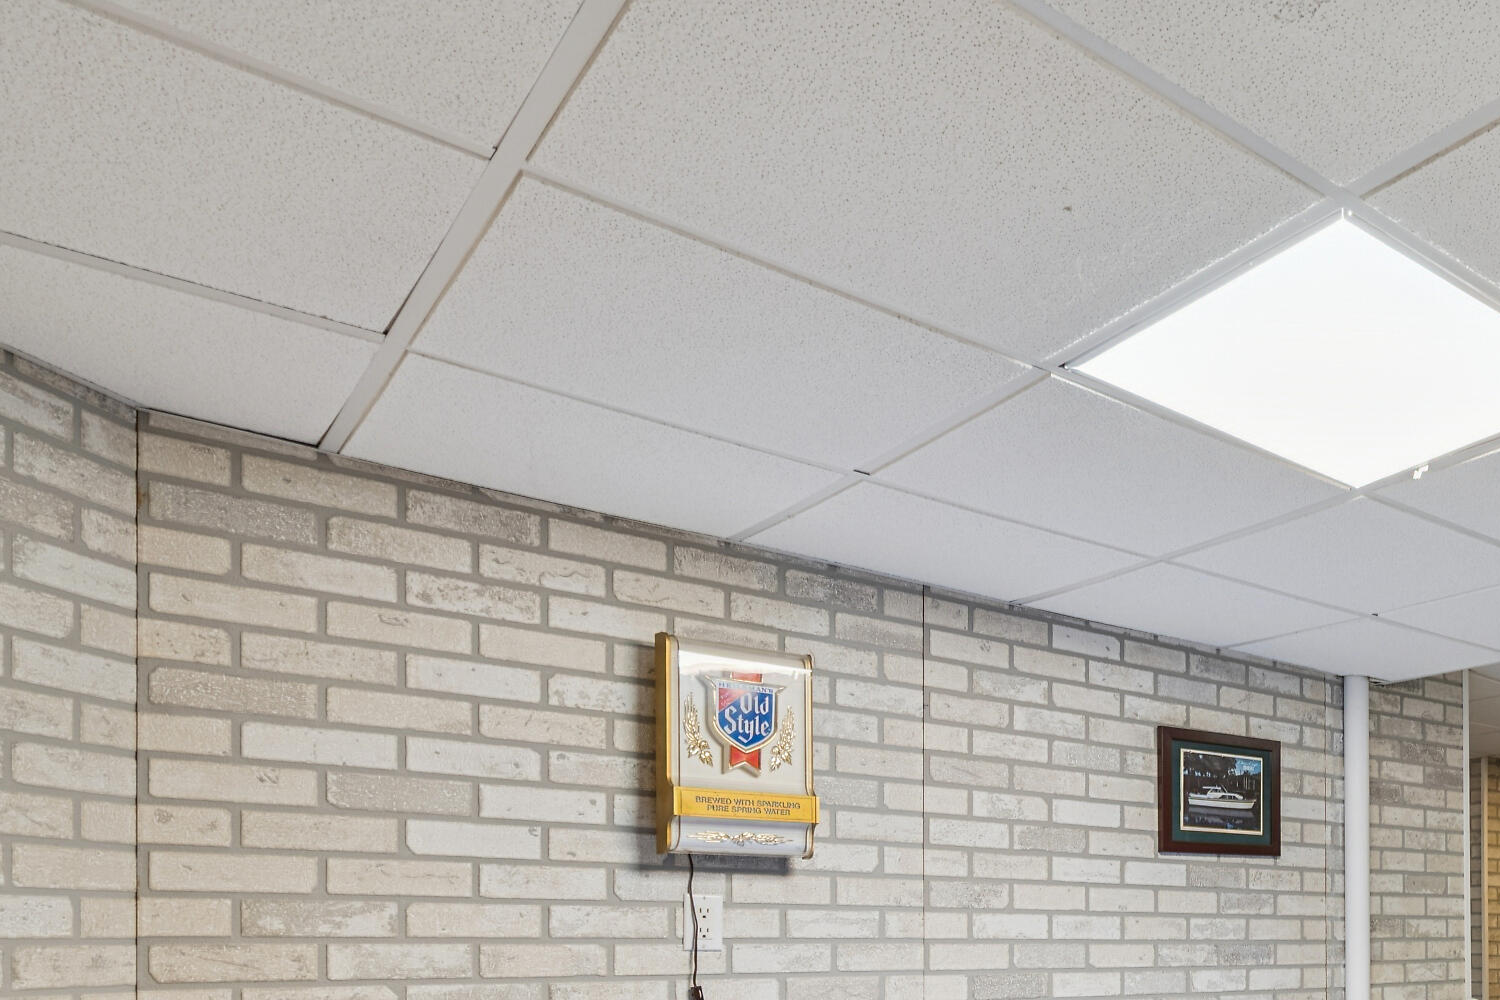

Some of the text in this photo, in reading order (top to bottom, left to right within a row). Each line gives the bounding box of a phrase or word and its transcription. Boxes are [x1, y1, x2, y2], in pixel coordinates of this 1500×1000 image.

[739, 692, 770, 716] Old
[723, 705, 770, 744] Style
[695, 795, 801, 810] BREWED WITH SPARKLING
[706, 804, 791, 816] PURE SPRING WATER
